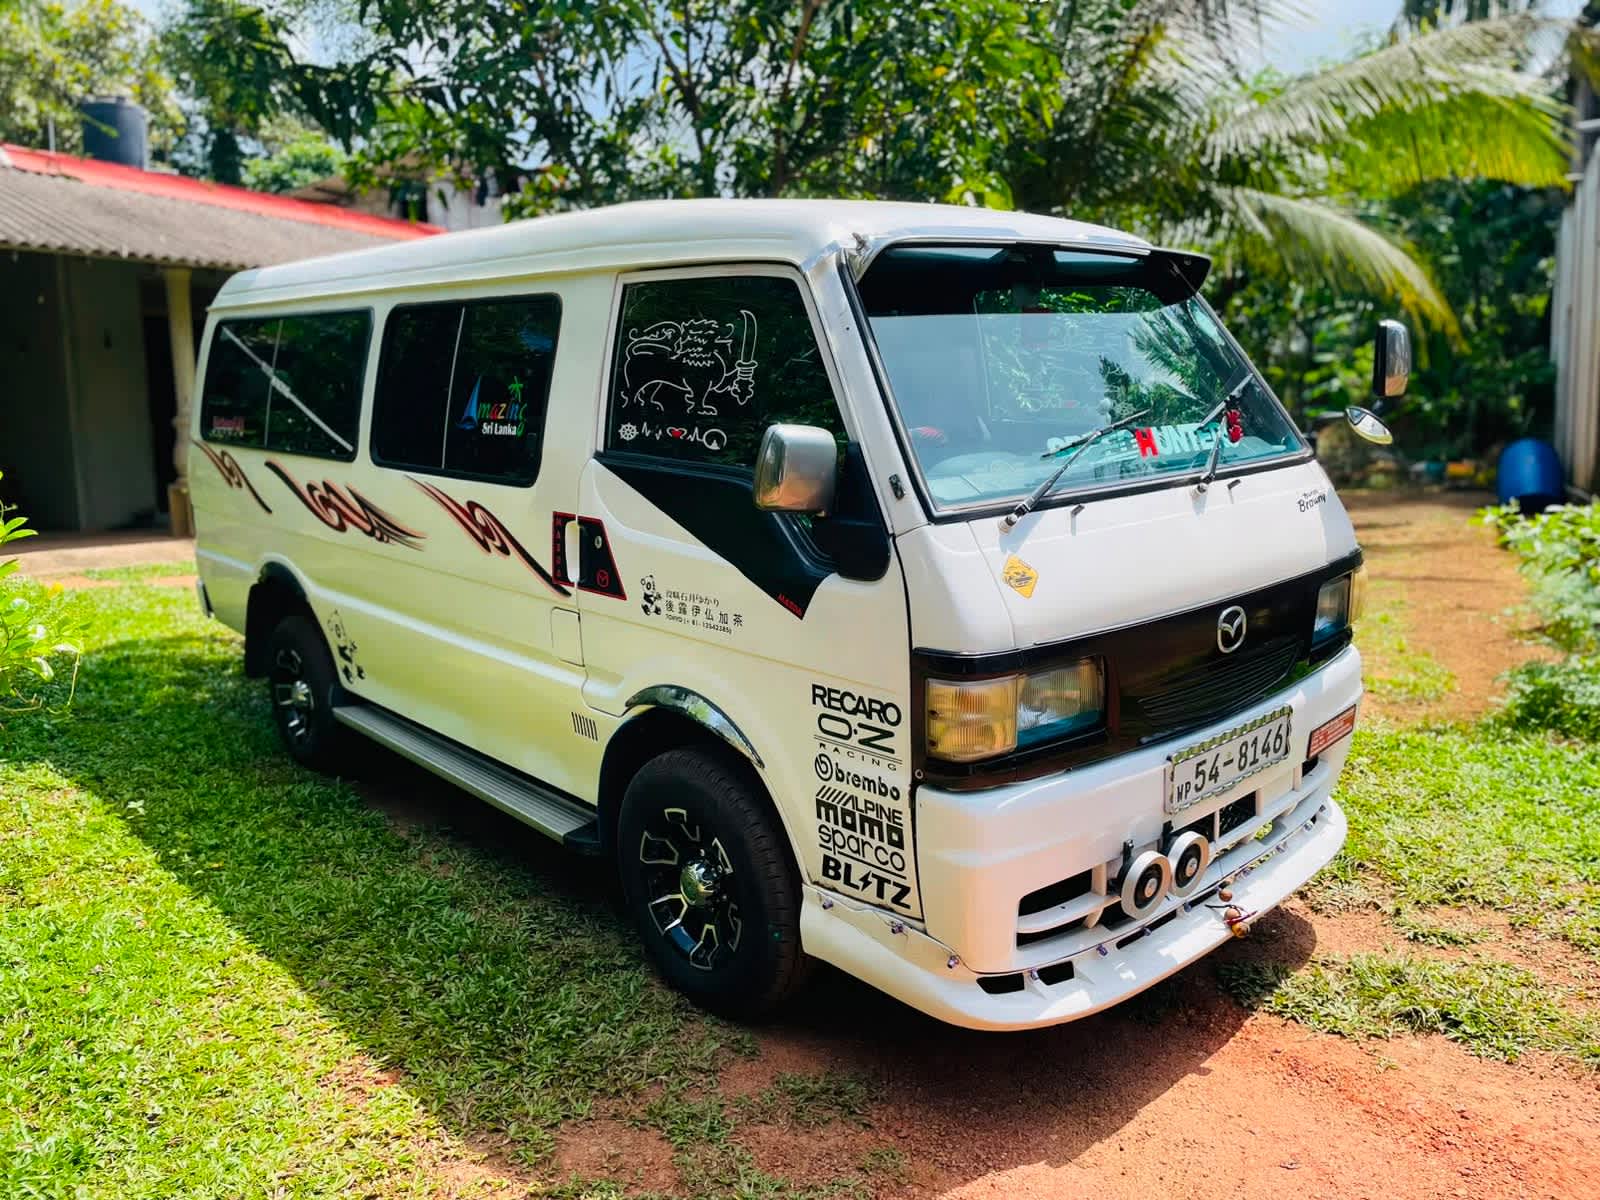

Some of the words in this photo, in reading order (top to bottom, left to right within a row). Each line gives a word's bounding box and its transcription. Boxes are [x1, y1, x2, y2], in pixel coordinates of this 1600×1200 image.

[481, 422, 493, 434] Sri
[494, 423, 517, 436] Lanka
[811, 683, 902, 727] RECARO
[819, 742, 897, 772] RACING
[1194, 723, 1284, 794] 54-8146
[835, 762, 901, 801] brembo
[815, 797, 905, 851] momo
[841, 794, 903, 828] ALPINE
[818, 823, 906, 872] sparco
